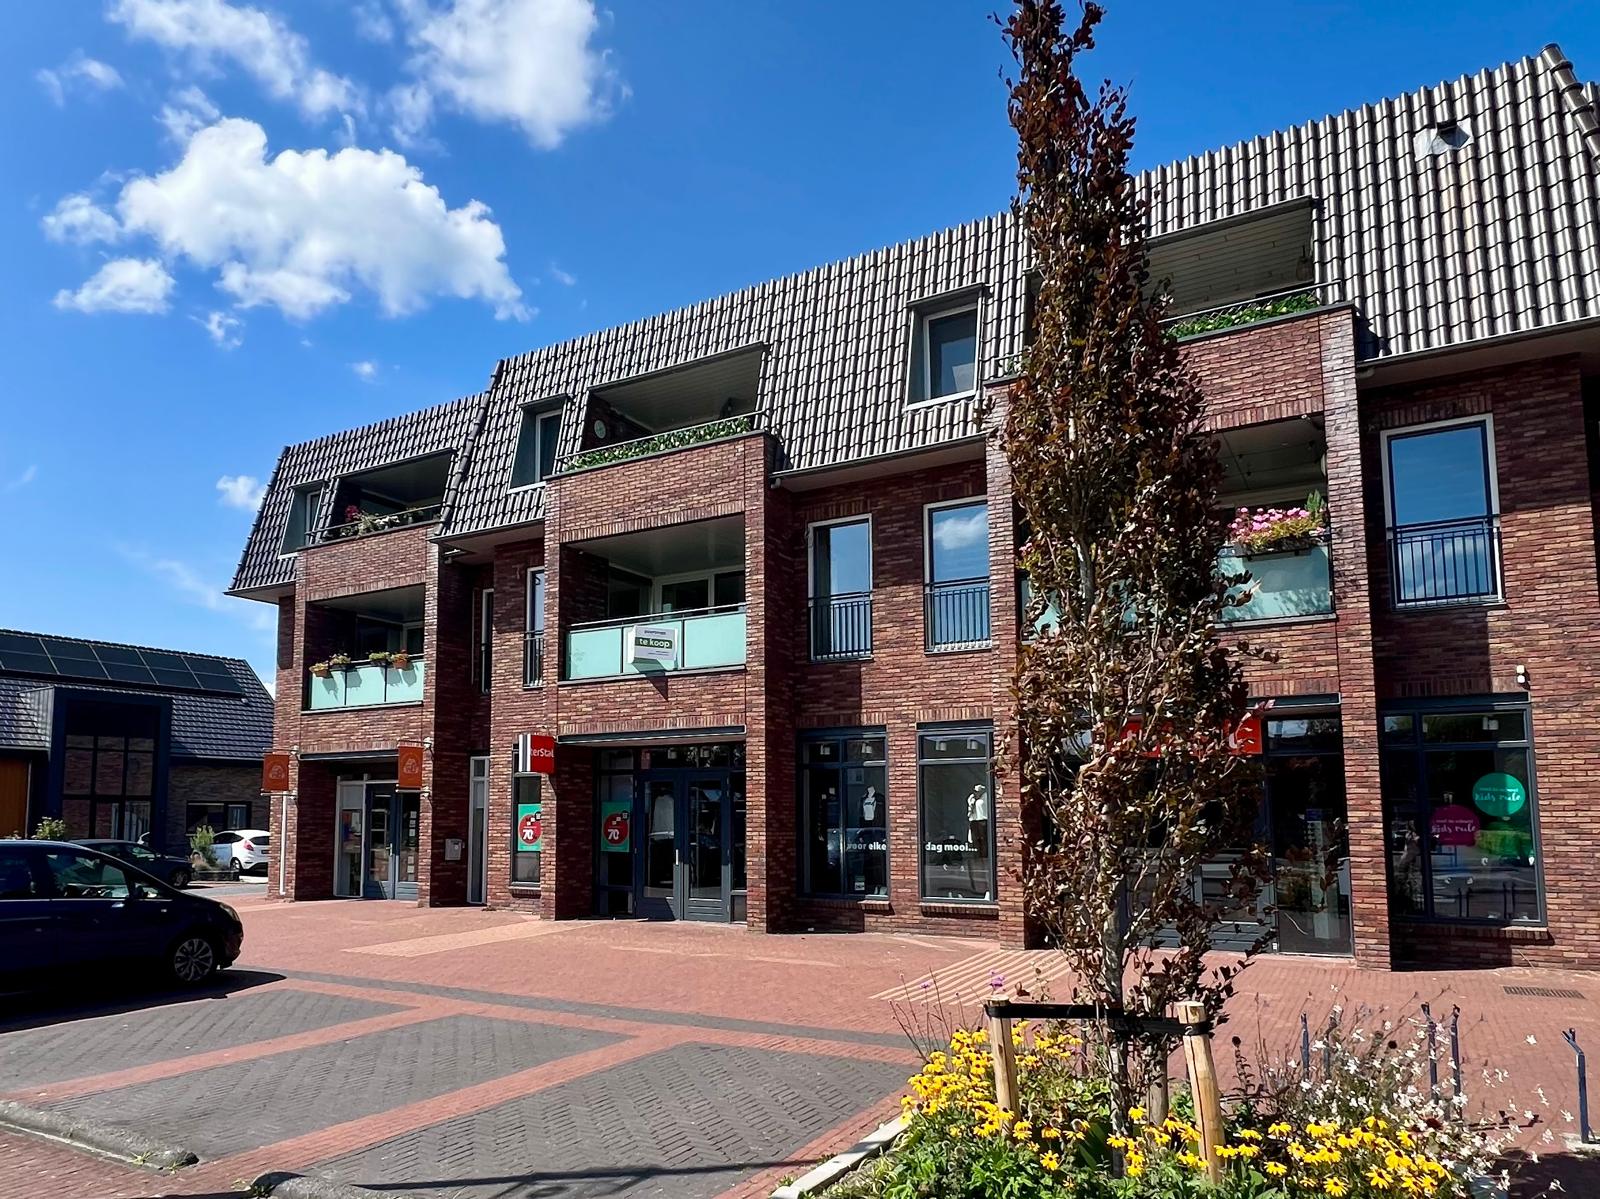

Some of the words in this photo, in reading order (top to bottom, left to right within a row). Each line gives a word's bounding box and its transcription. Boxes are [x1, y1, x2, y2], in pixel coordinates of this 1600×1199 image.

[650, 639, 670, 648] koop
[1455, 823, 1476, 833] rule
[846, 843, 867, 852] voor
[868, 841, 887, 851] elke
[925, 841, 943, 853] dag
[943, 842, 978, 852] mooi...
